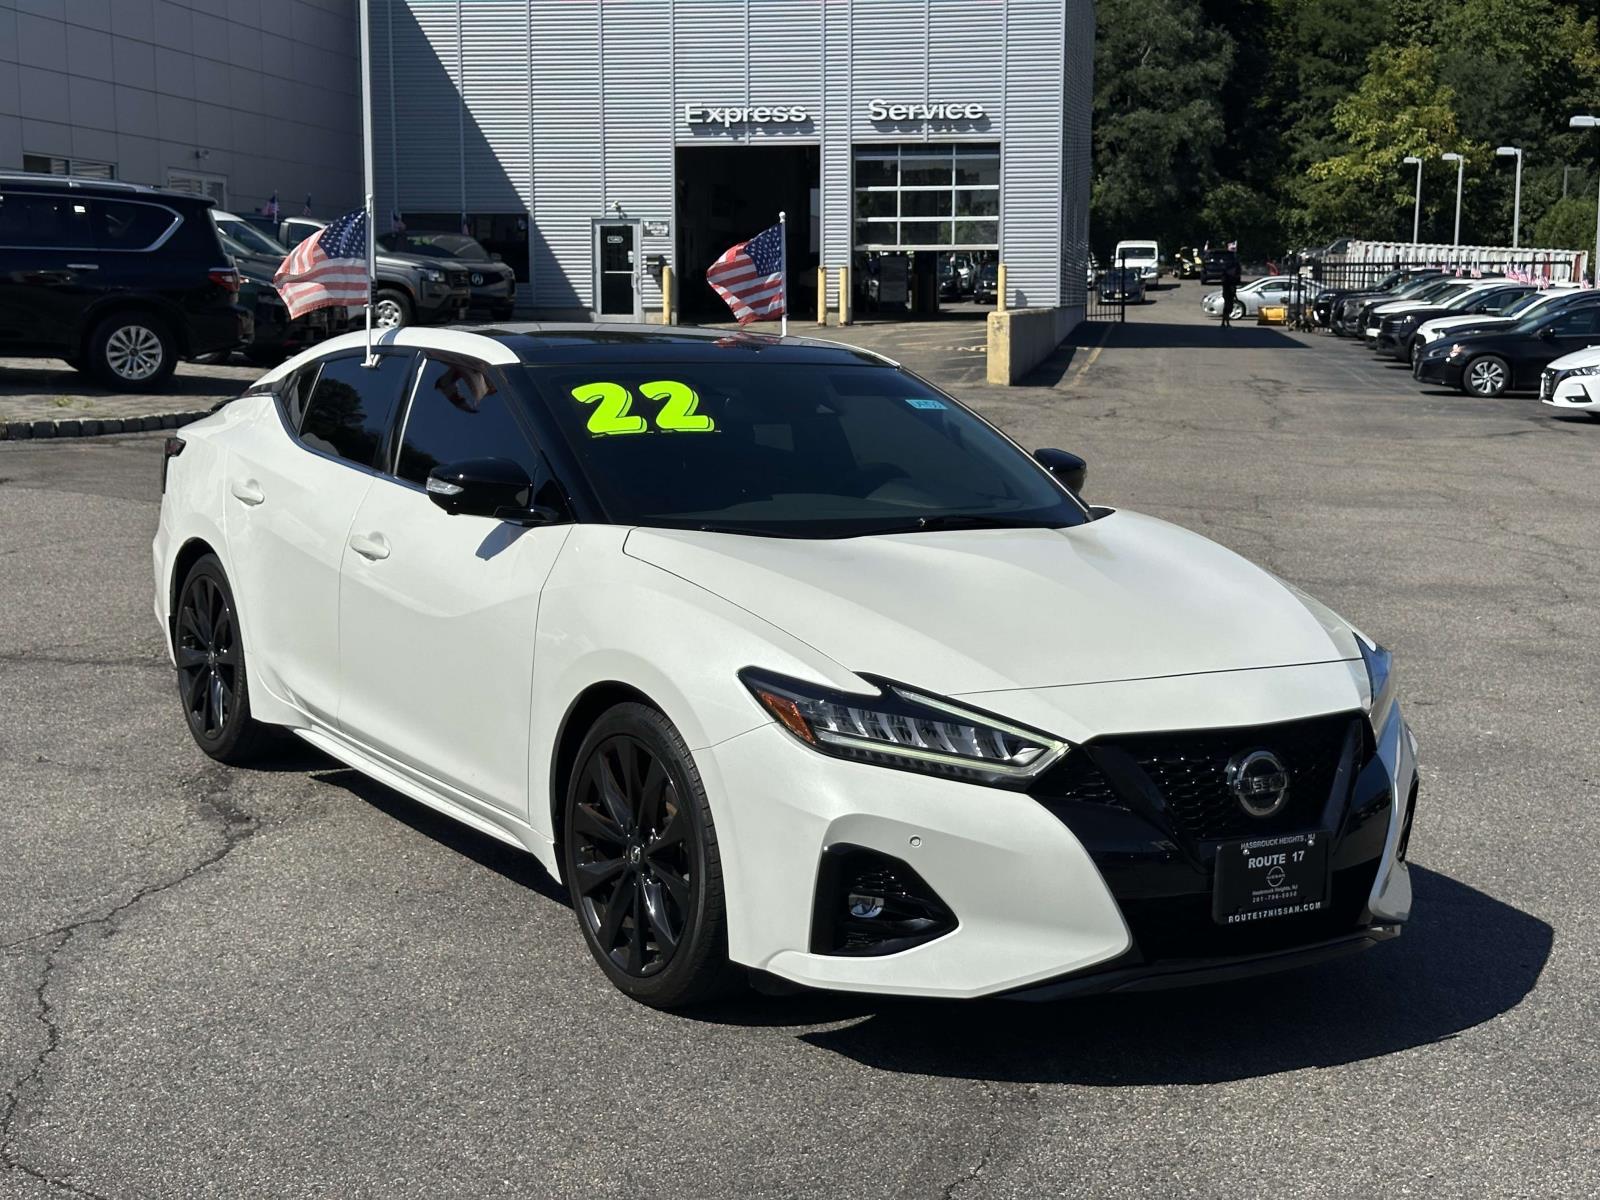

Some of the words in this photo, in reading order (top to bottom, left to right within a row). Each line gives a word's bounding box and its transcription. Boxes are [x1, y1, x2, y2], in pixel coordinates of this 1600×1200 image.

[684, 103, 807, 127] Express
[867, 98, 984, 121] Service
[571, 380, 715, 436] 22
[1241, 838, 1278, 850] HASBROUCK
[1248, 853, 1286, 869] ROUTE
[1292, 850, 1305, 863] 17
[1228, 901, 1321, 923] ROUTE17NISSAN.COM
